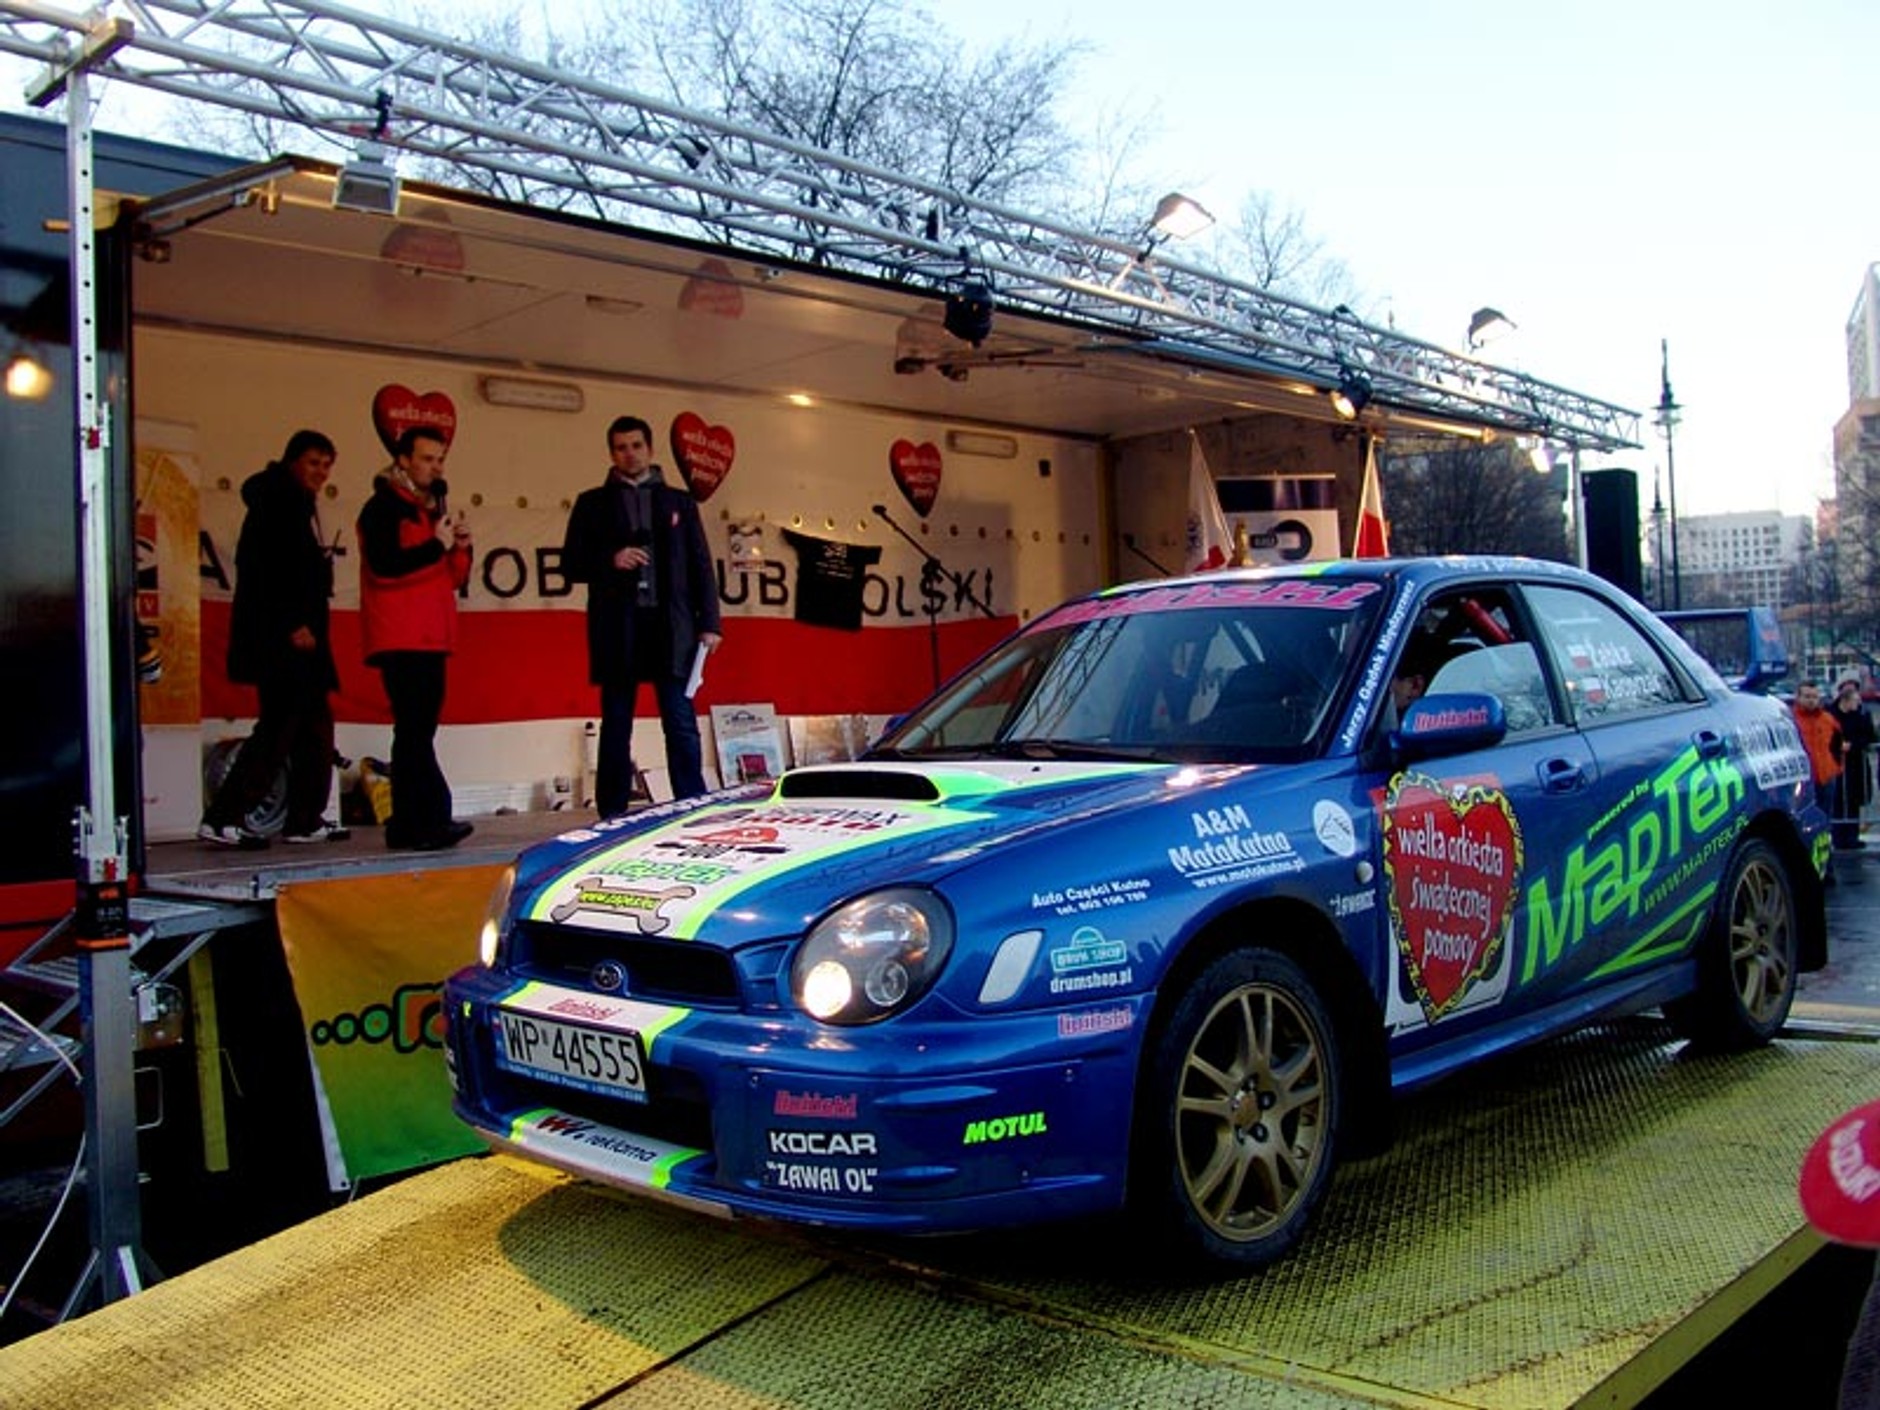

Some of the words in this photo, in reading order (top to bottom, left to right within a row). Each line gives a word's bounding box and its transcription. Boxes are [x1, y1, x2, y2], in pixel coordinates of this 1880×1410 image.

[863, 560, 993, 618] OLSKI
[1341, 702, 1368, 748] Jerzy
[1190, 804, 1252, 838] A&M
[1168, 831, 1292, 873] MotoKutno
[1397, 812, 1446, 861] wielka
[1448, 823, 1504, 877] orkiestra
[1192, 856, 1307, 889] www.motokutno.pl
[1032, 892, 1064, 908] Auto
[1110, 878, 1151, 893] Kutno
[1410, 864, 1492, 940] świątecznej
[1421, 927, 1478, 977] pomocy
[1050, 968, 1133, 993] drumshop.pl
[503, 1015, 540, 1062] WP
[552, 1027, 639, 1085] 44555
[769, 1131, 878, 1155] KOCAR
[963, 1112, 1048, 1144] MOTUL
[584, 1132, 660, 1164] reklama
